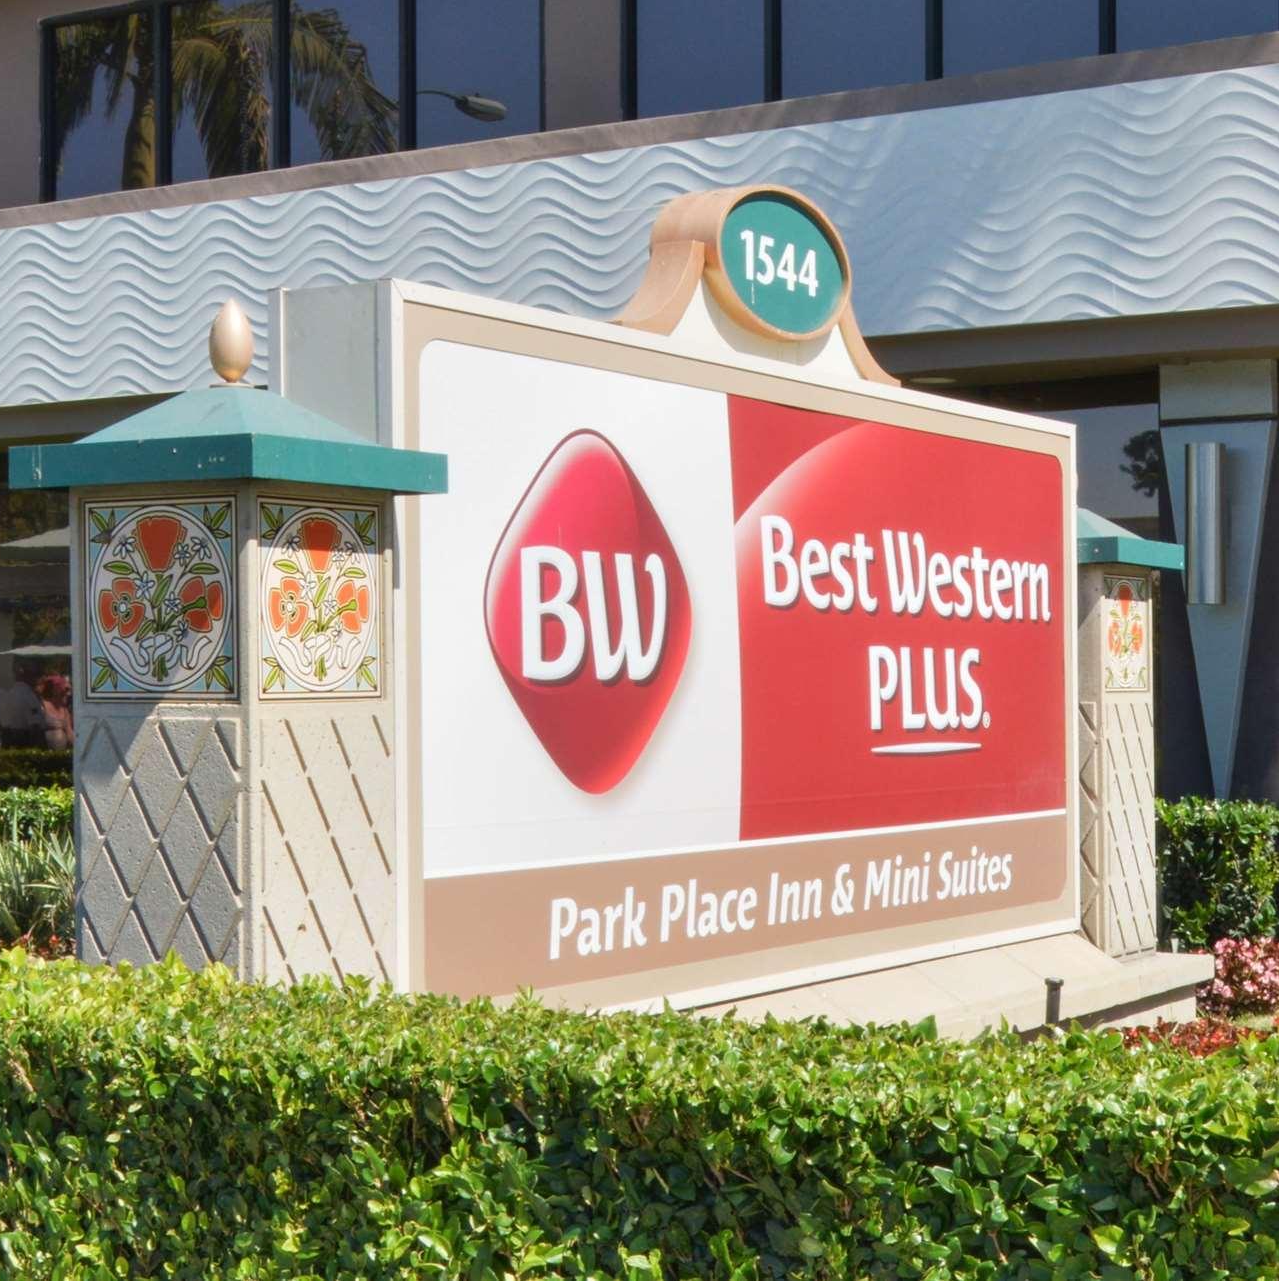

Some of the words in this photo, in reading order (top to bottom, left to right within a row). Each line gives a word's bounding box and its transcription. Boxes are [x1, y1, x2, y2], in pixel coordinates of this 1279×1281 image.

[740, 229, 819, 297] 1544
[520, 545, 666, 681] BW
[760, 515, 878, 612] Best
[882, 529, 1051, 622] Western
[549, 885, 647, 959] Park
[660, 878, 758, 942] Place
[767, 872, 822, 926] Inn
[831, 863, 854, 916] &
[863, 852, 930, 910] Mini
[936, 845, 1013, 900] Suites
